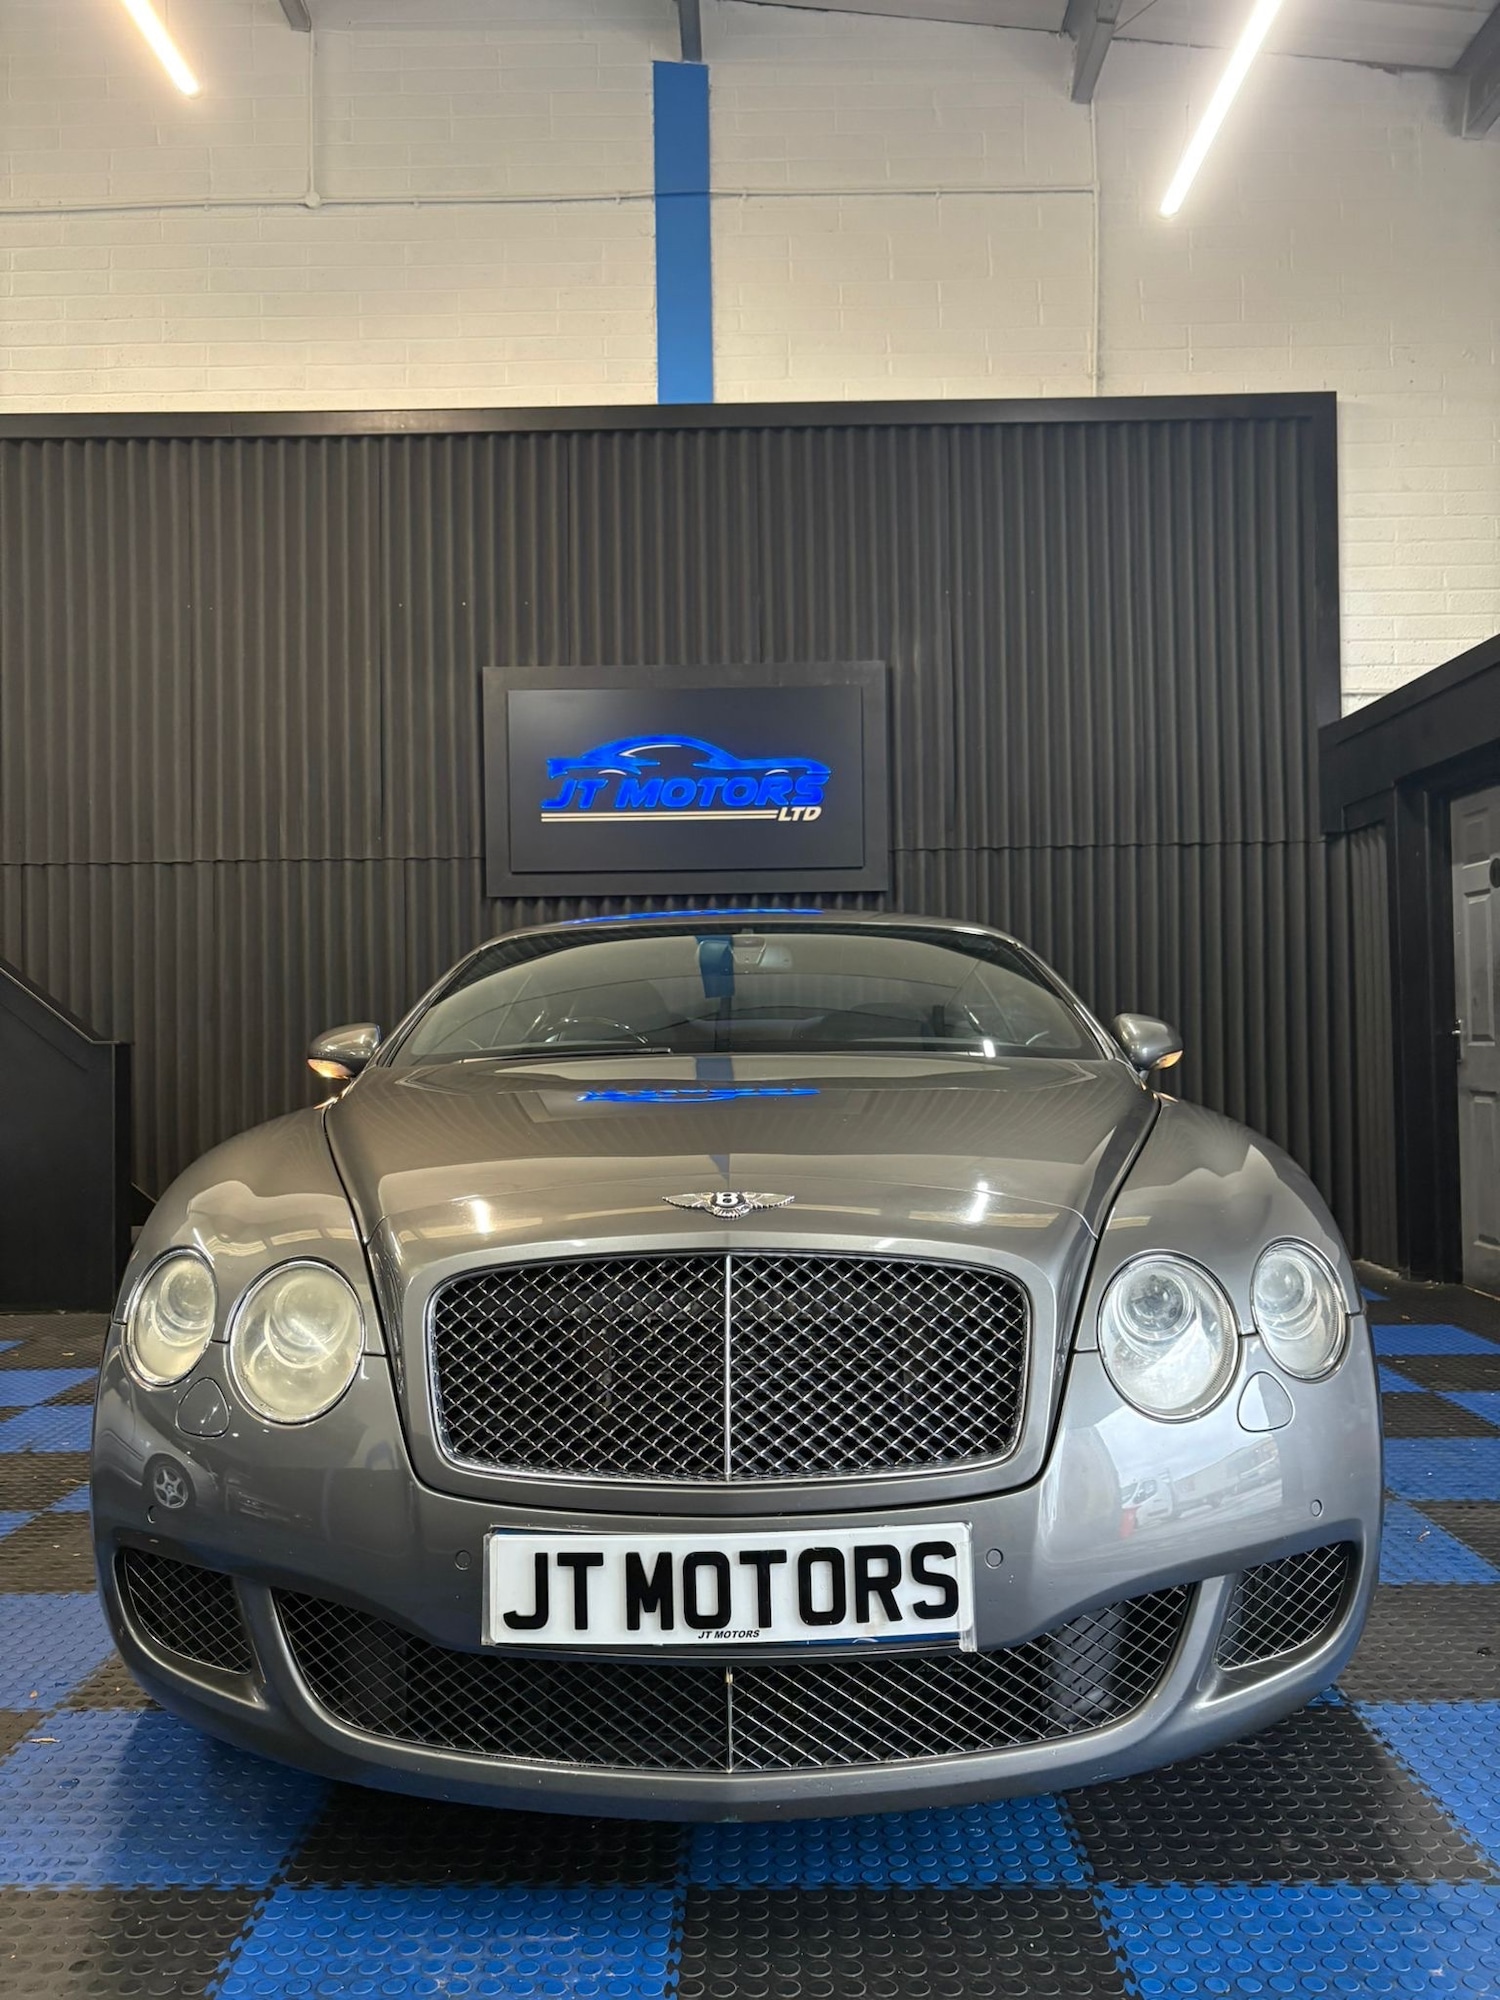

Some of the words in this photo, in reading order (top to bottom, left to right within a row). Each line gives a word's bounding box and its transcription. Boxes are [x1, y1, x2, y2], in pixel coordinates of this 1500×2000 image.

[541, 778, 609, 809] JT
[615, 775, 831, 808] MOTORS
[777, 806, 822, 822] LTD
[715, 1191, 739, 1206] B
[503, 1551, 604, 1631] JT
[625, 1540, 959, 1631] MOTORS
[698, 1630, 712, 1639] JT
[714, 1629, 760, 1639] MOTORS
